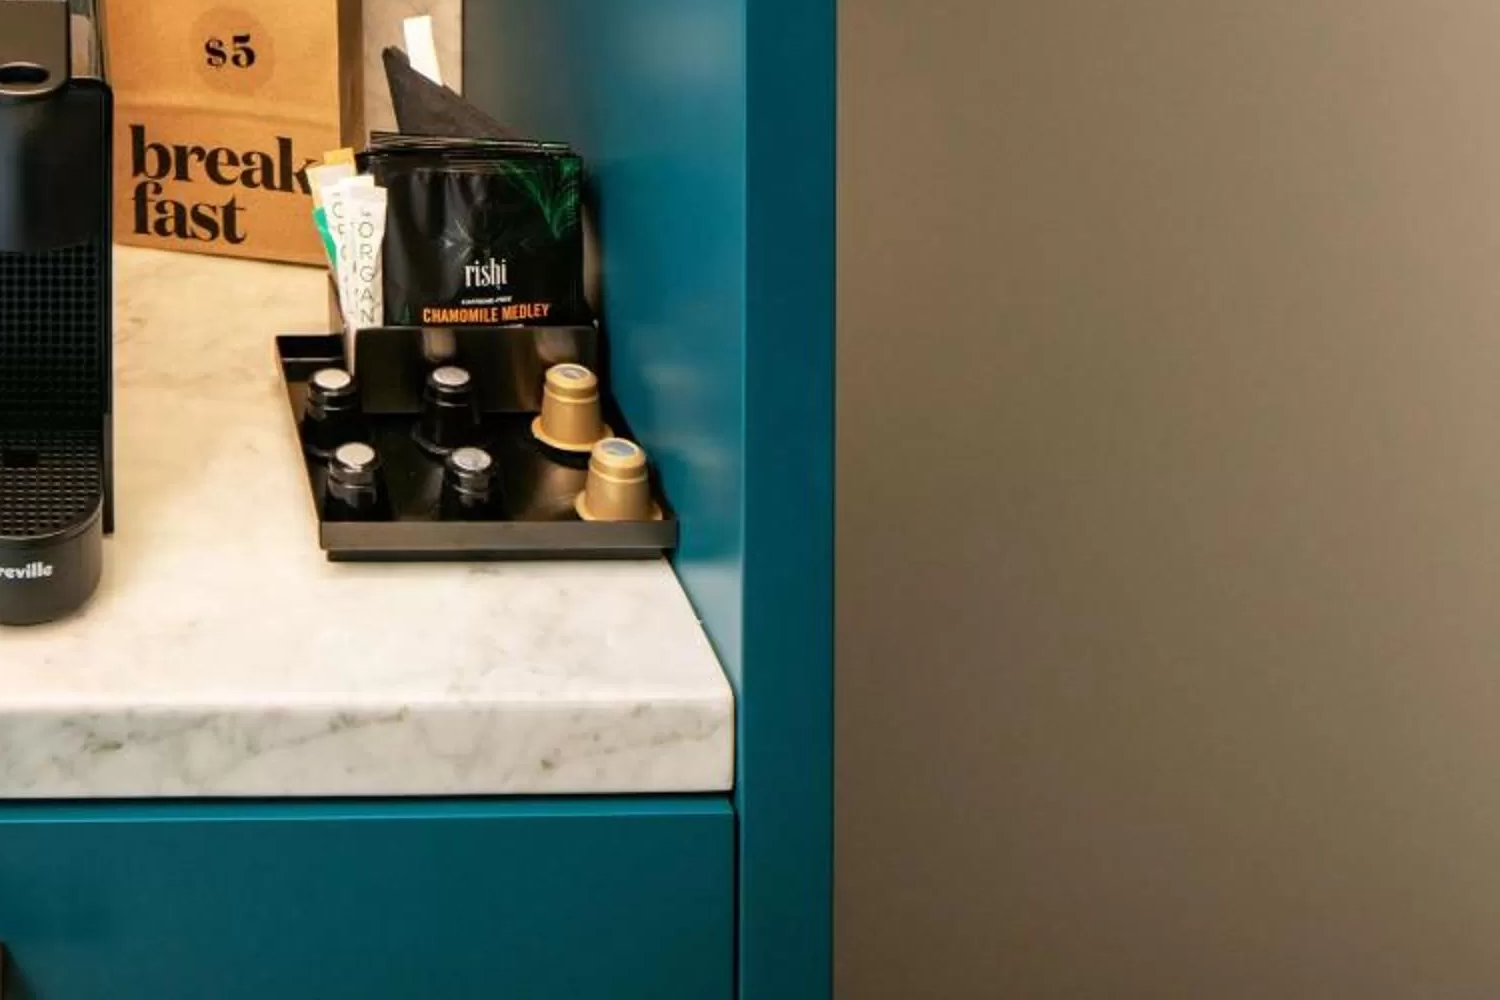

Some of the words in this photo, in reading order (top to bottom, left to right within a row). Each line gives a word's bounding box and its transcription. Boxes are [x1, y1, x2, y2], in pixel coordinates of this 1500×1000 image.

[204, 33, 256, 69] $5
[128, 124, 319, 196] break
[132, 180, 248, 245] fast
[464, 257, 508, 288] rishi
[423, 306, 500, 324] CHAMOMILE
[501, 302, 551, 321] MEDLEY
